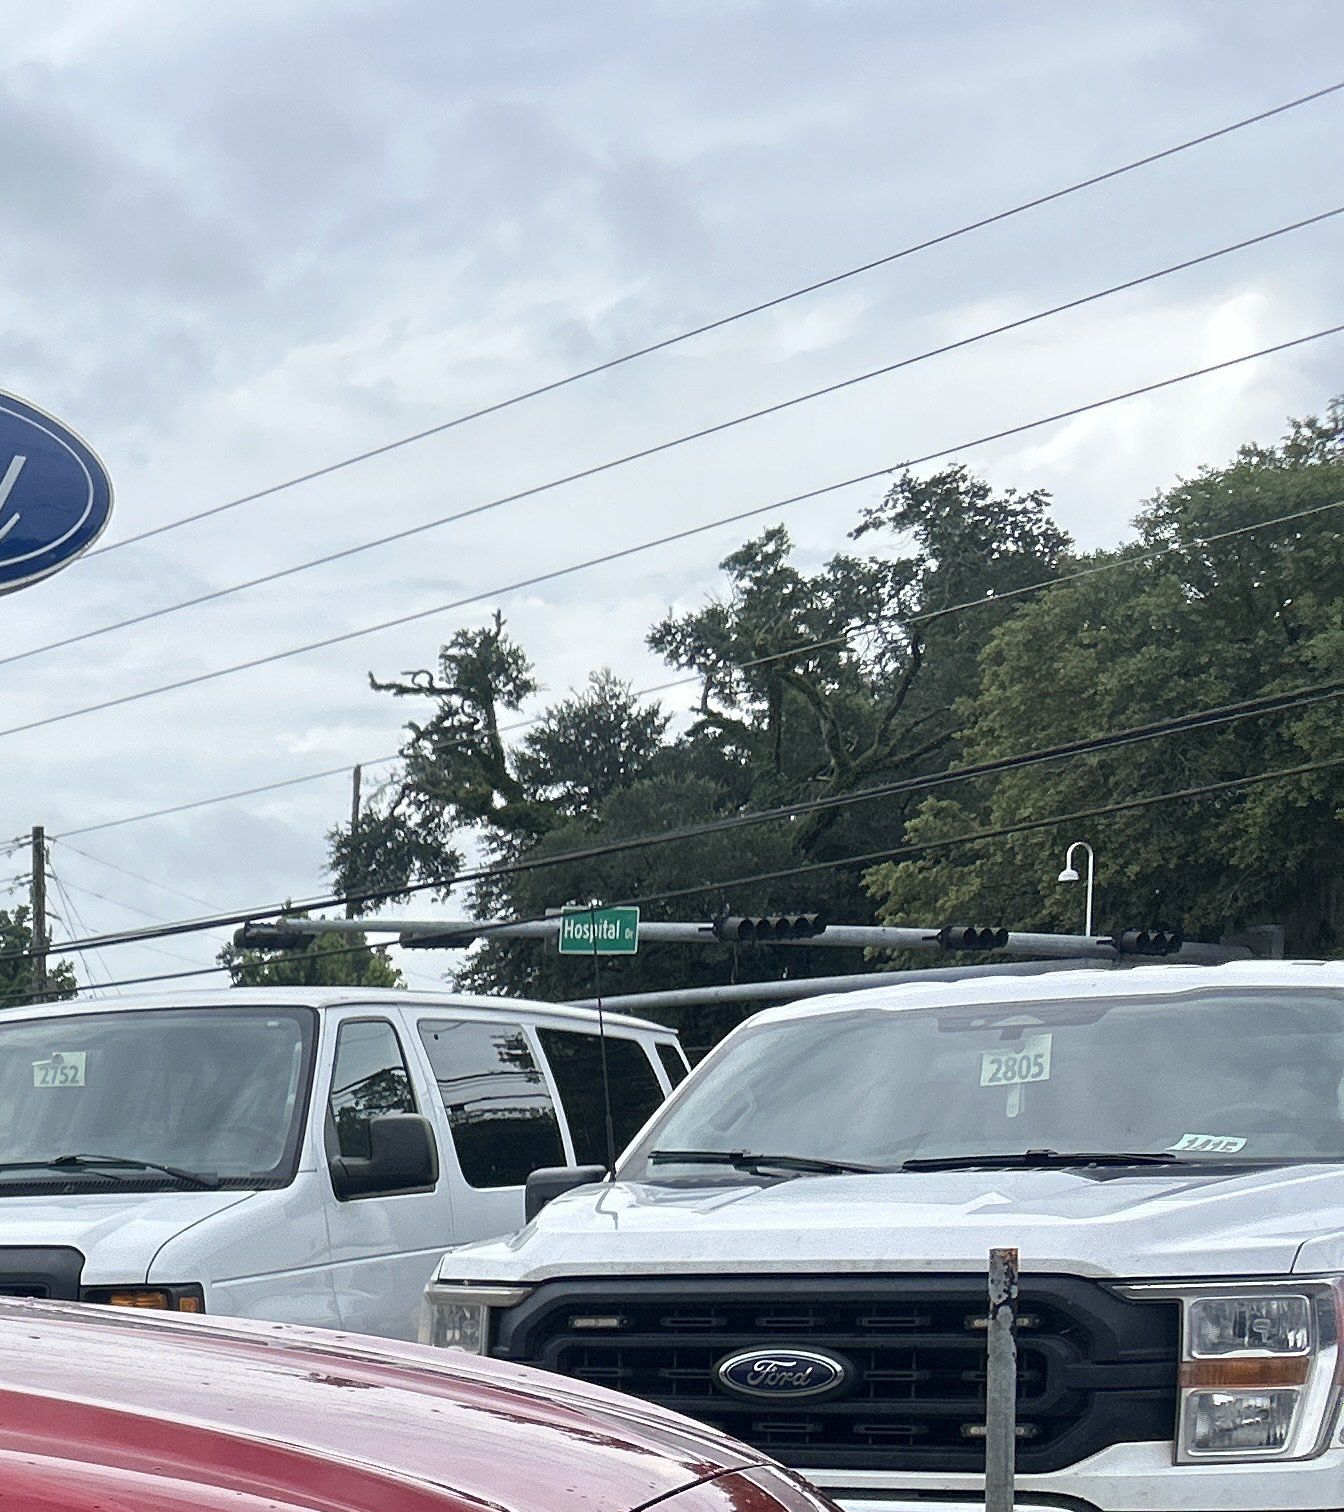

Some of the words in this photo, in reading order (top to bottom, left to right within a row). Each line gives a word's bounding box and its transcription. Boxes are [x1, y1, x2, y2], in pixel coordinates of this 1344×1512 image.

[563, 918, 621, 943] Hospital
[39, 1065, 80, 1085] 2752
[987, 1053, 1045, 1083] 2805
[746, 1359, 813, 1386] Ford
